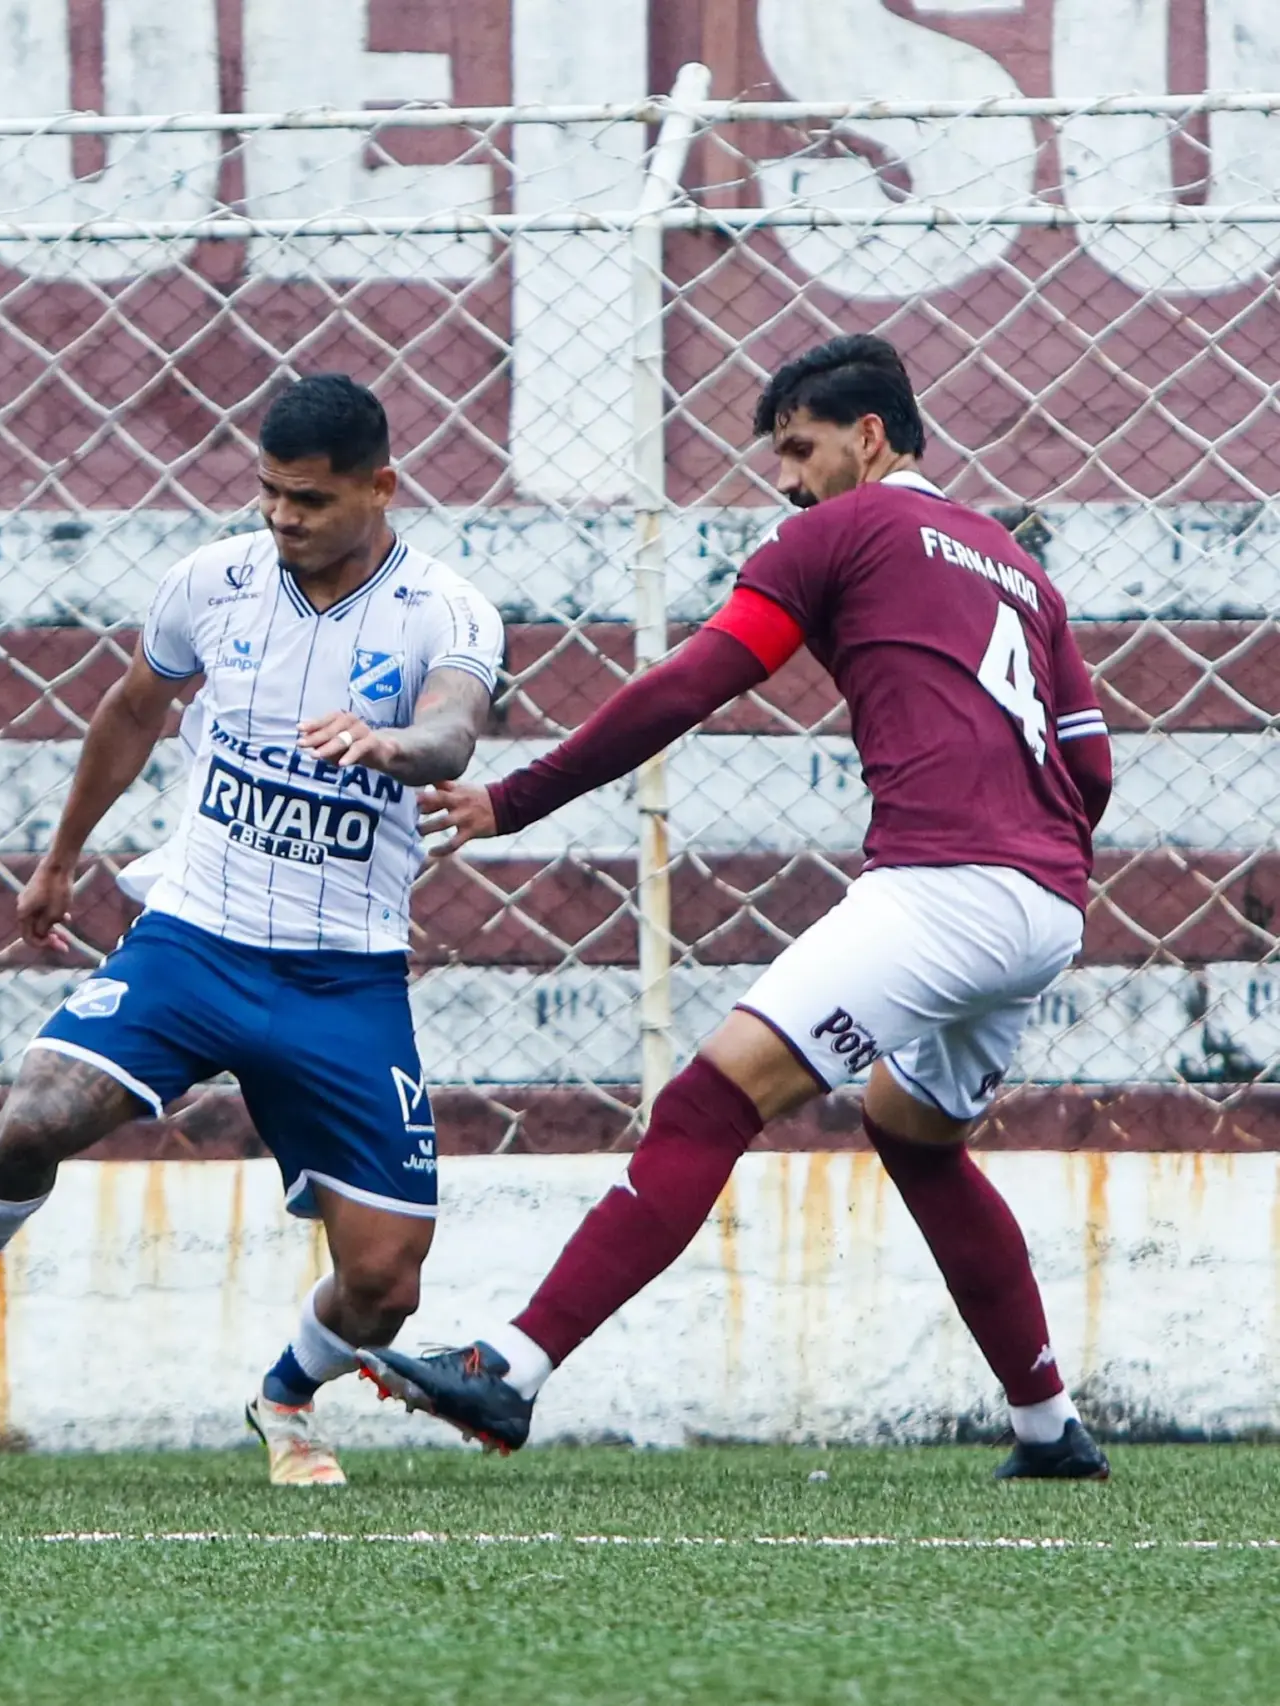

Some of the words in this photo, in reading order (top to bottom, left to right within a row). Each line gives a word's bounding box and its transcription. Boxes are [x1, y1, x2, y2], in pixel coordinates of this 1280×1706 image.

[919, 526, 1039, 613] FERNANDO
[976, 600, 1048, 766] 4
[205, 768, 371, 850] RIVALO
[231, 825, 320, 864] .BET.BR
